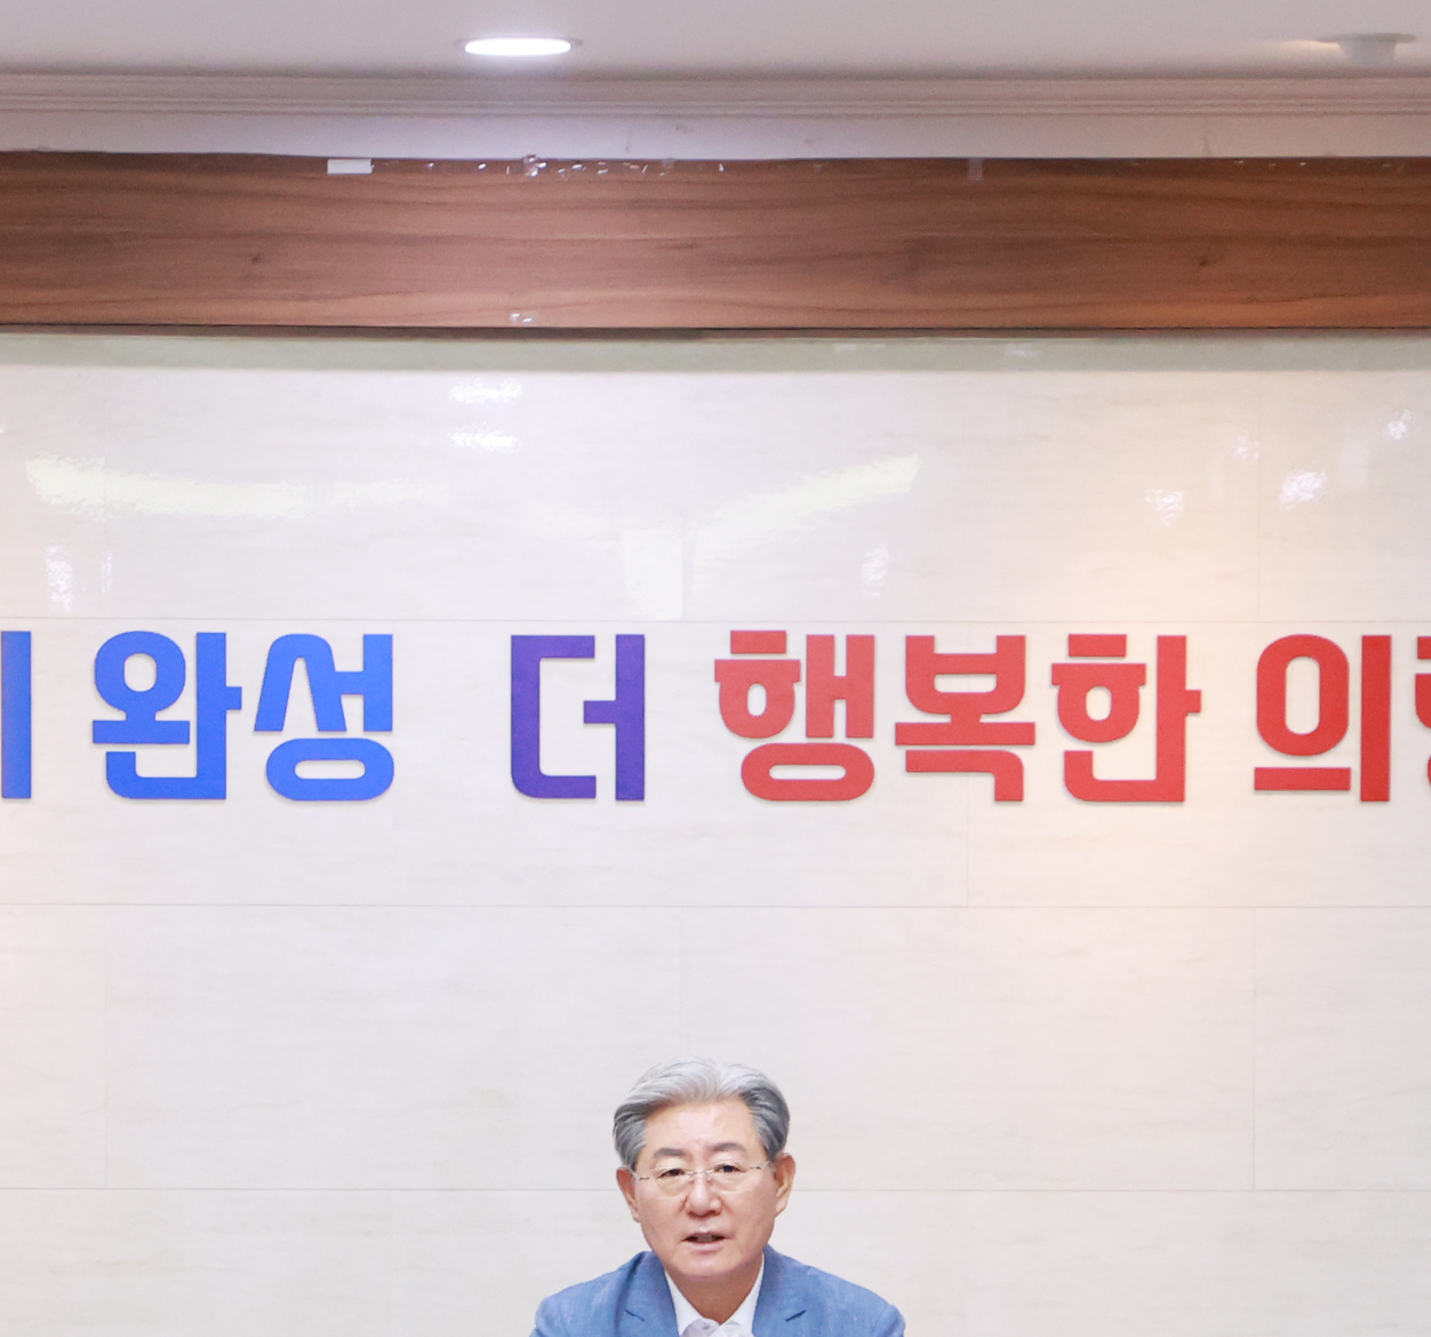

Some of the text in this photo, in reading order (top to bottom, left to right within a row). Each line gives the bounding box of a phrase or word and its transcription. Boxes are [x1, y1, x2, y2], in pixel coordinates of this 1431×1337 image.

[92, 631, 394, 801] 완성
[511, 635, 644, 800] 더
[714, 631, 1201, 802] 행복한
